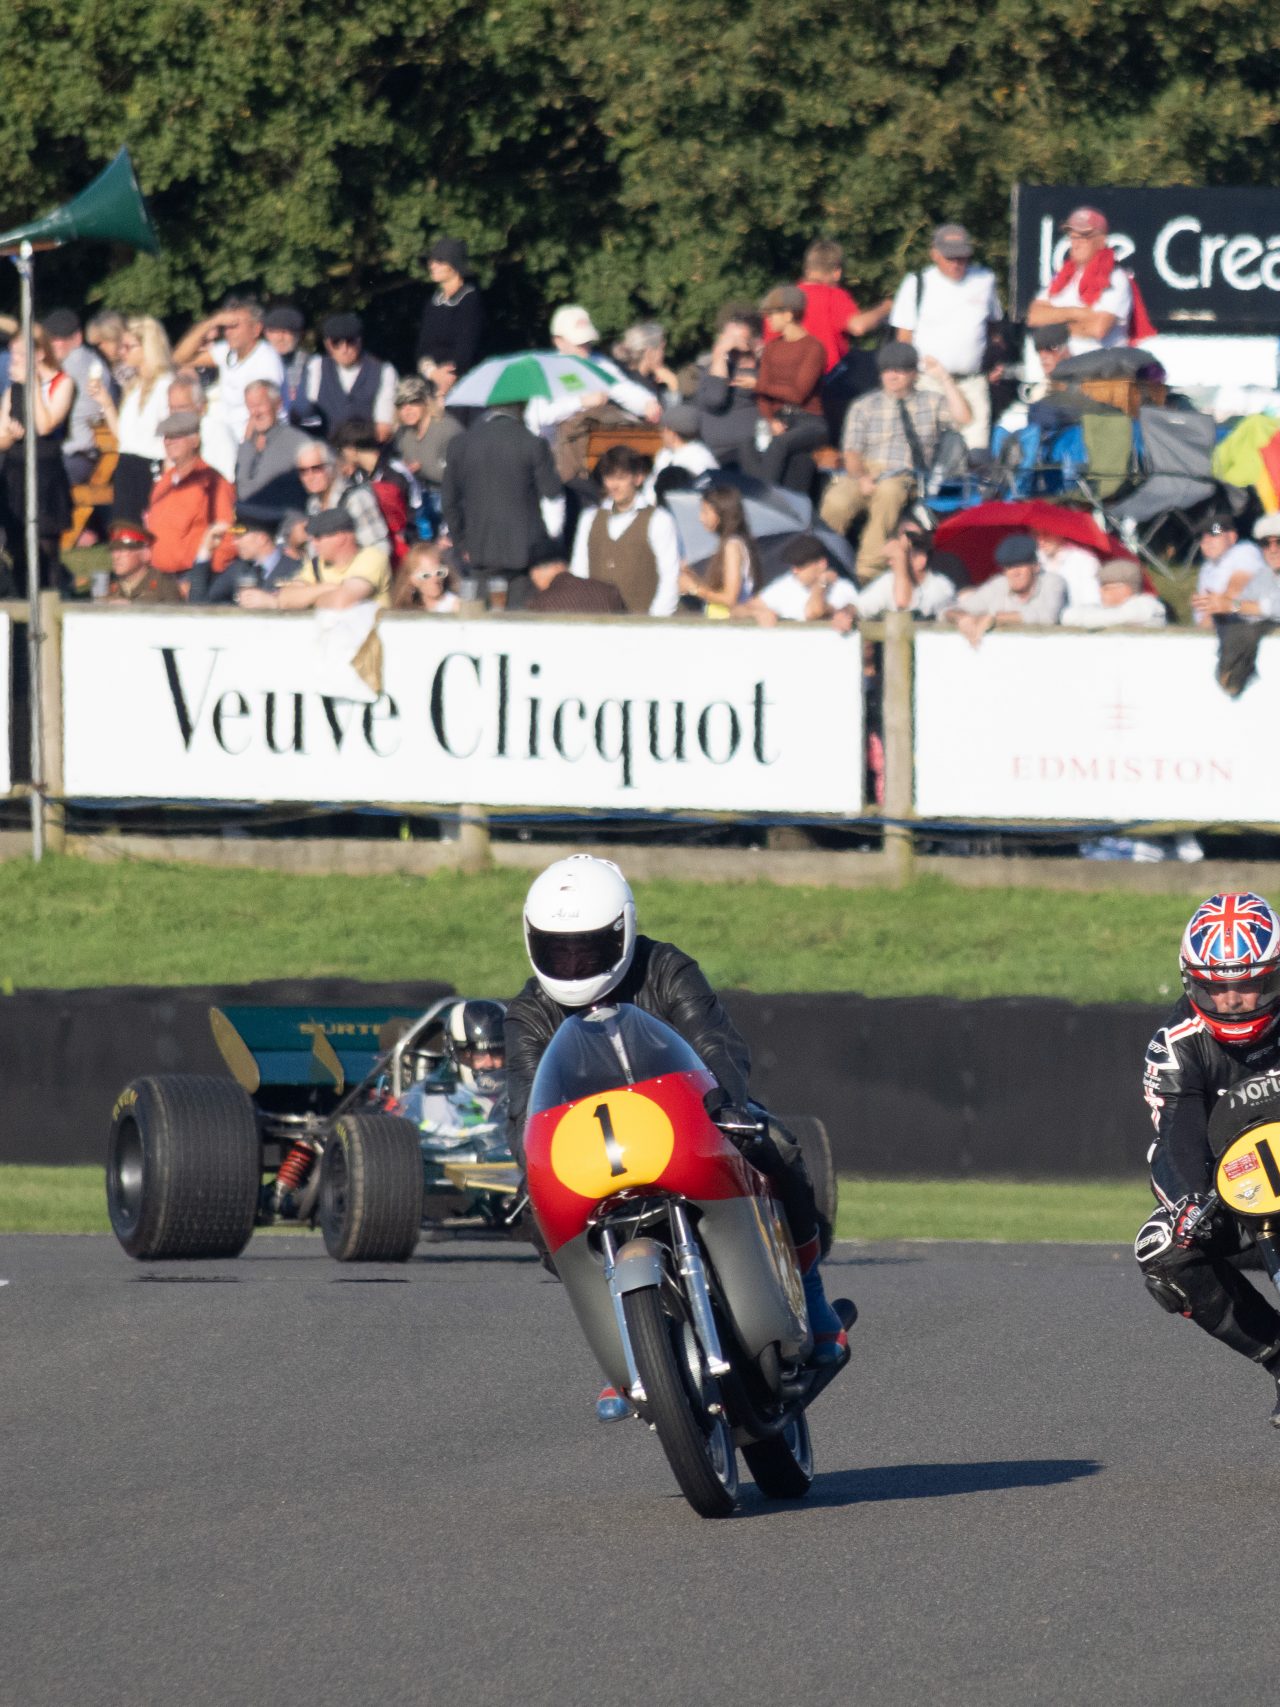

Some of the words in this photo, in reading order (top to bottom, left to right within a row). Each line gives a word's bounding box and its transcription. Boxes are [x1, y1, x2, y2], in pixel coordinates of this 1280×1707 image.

[150, 646, 402, 758] Veuve
[429, 651, 781, 790] Clicquot
[1012, 755, 1234, 784] EDMISTON
[592, 1102, 629, 1178] 1
